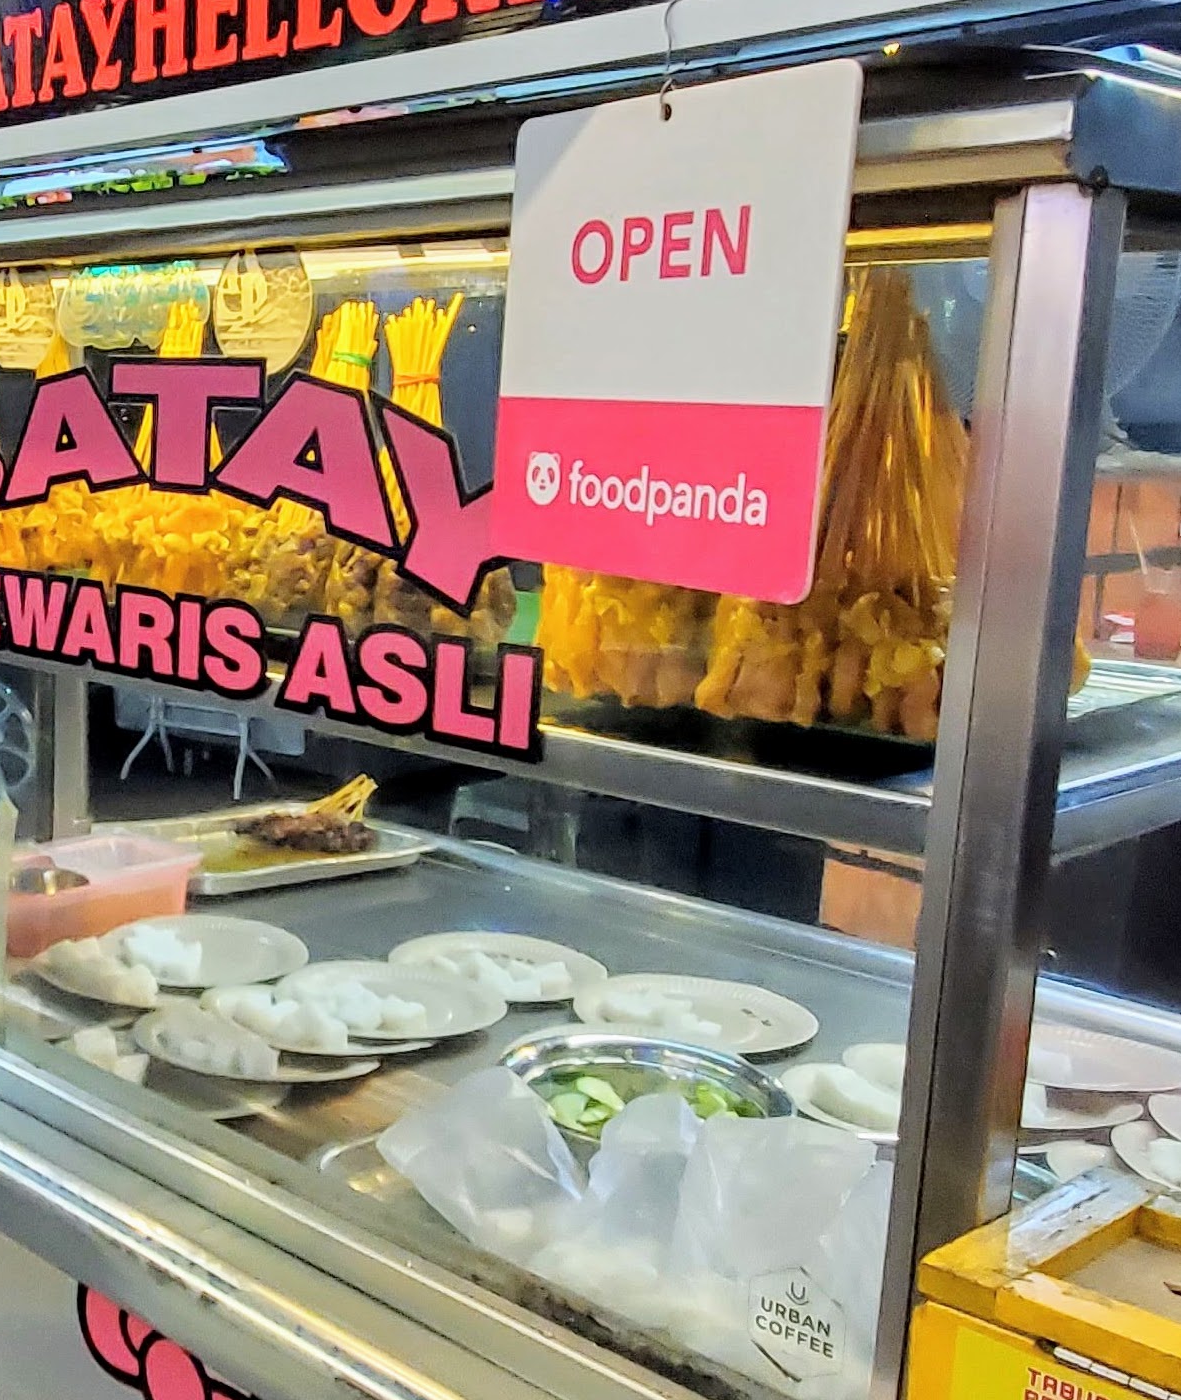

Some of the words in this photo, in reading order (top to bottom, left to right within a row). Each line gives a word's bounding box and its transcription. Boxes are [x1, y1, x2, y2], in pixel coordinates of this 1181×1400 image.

[571, 205, 751, 285] OPEN
[569, 458, 768, 526] foodpanda
[277, 615, 543, 761] ASLI
[755, 1315, 834, 1359] COFFEE
[761, 1296, 831, 1337] URBAN
